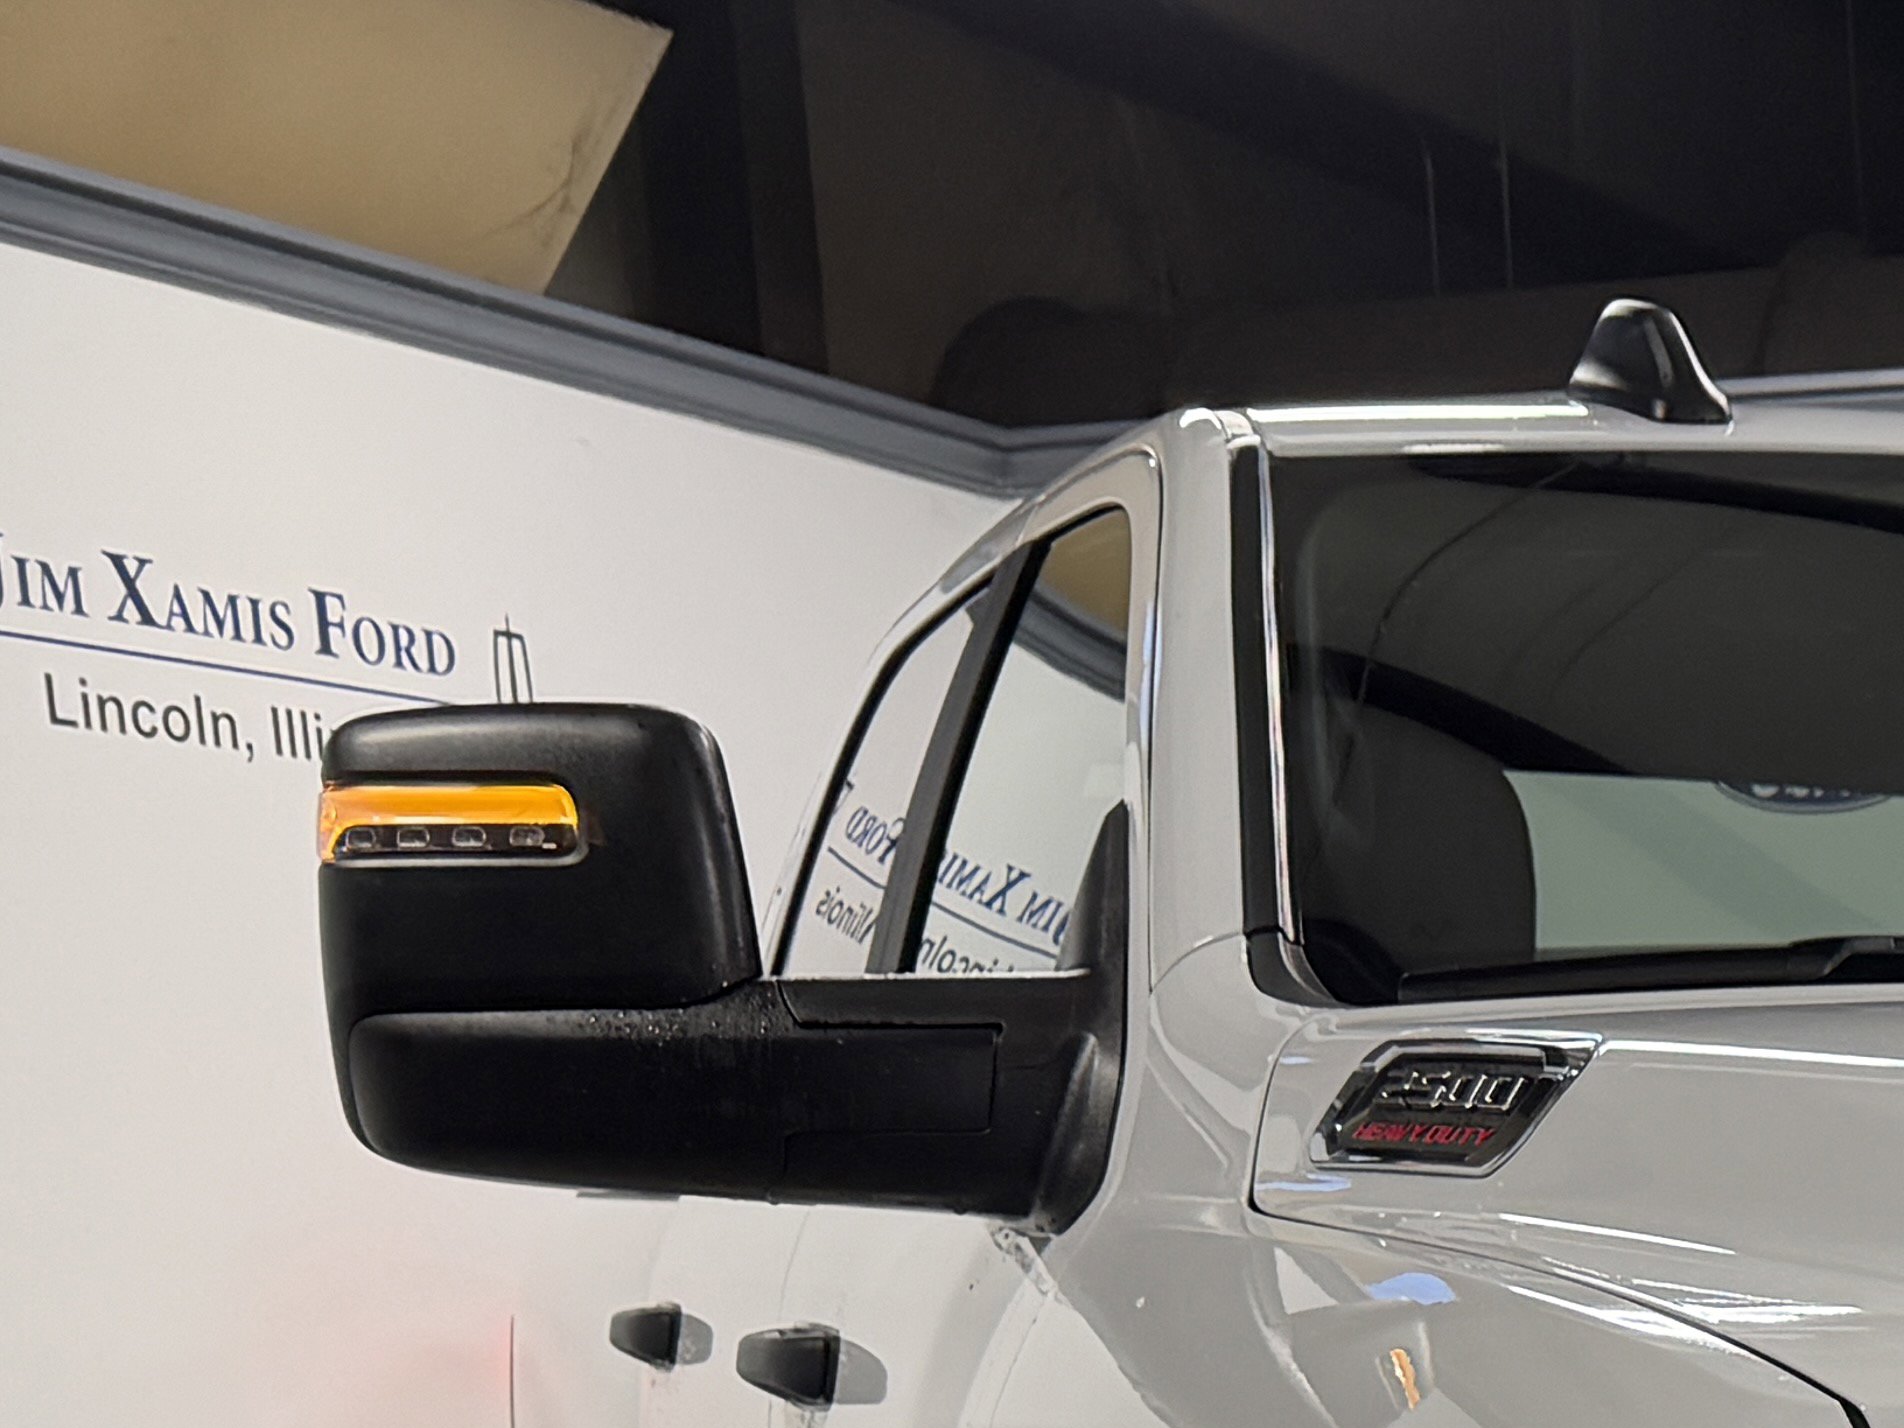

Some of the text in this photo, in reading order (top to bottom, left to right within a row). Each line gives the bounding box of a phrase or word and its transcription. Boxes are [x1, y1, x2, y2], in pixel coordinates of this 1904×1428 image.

[0, 531, 456, 676] IM XAMIS FORD
[44, 672, 255, 763] Lincoln,
[1351, 1121, 1428, 1143] HEAVY
